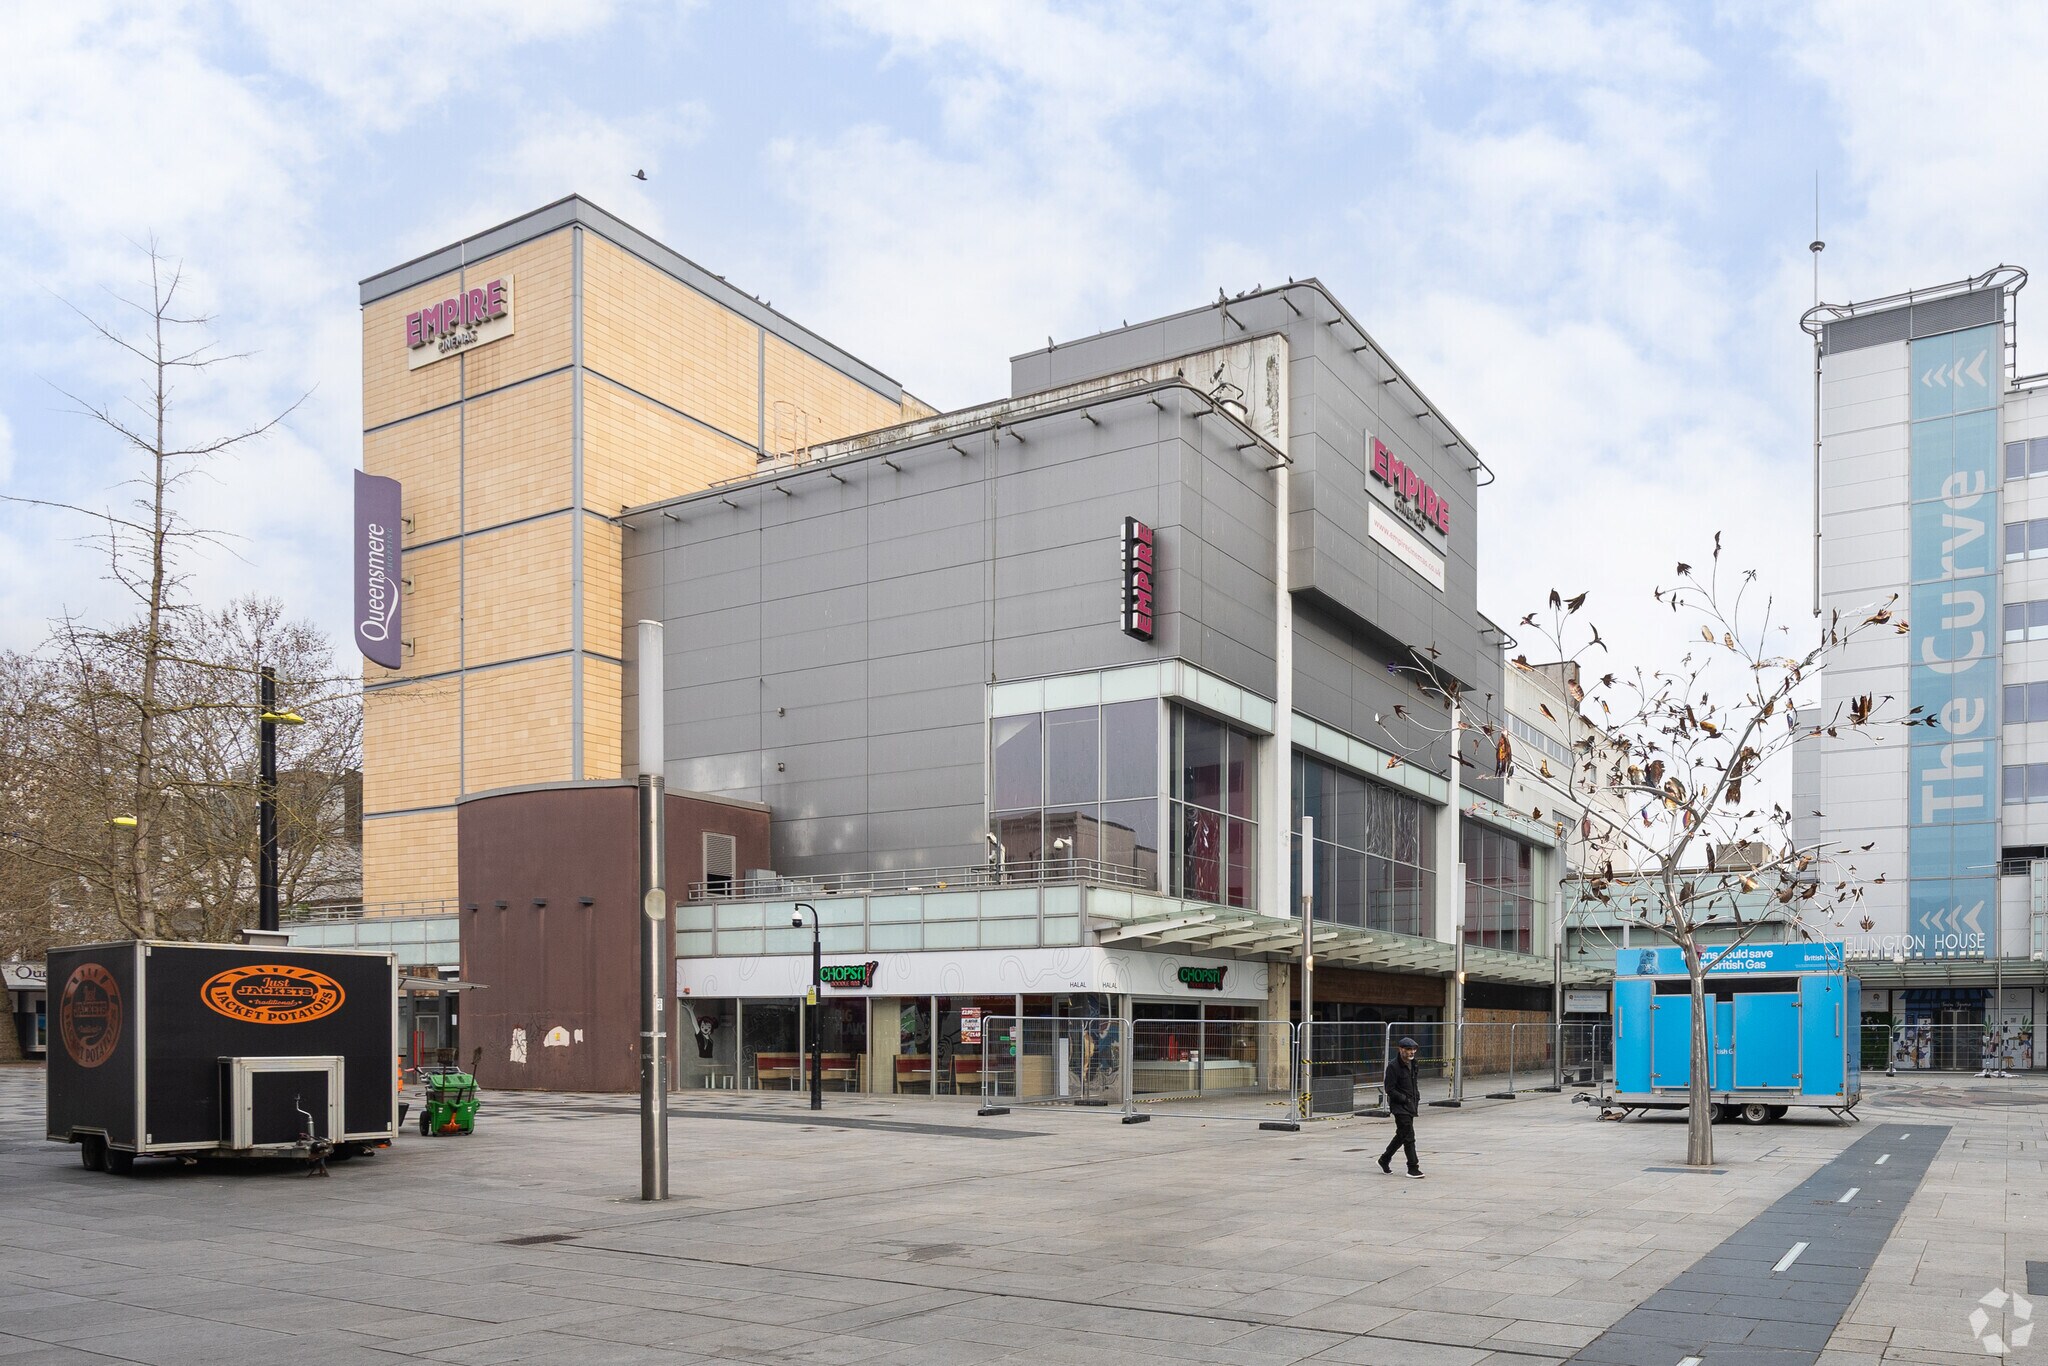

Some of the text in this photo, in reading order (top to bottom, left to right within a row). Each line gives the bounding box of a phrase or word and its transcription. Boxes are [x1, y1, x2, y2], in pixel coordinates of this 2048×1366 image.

[406, 279, 507, 349] EMPIRE
[438, 330, 478, 353] CINEMAS
[1370, 436, 1449, 535] EMPIRE
[1373, 518, 1441, 577] www.empirecinemas.co.uk
[360, 523, 398, 641] Queensmere
[1134, 521, 1153, 635] EMPIRE
[1921, 470, 1986, 824] The Curve
[1749, 950, 1773, 958] save
[1934, 933, 1985, 949] HOUSE
[1745, 959, 1766, 969] Gas
[237, 986, 314, 996] JACKETS
[262, 977, 290, 988] Just
[215, 991, 333, 1021] JACKET POTATOES
